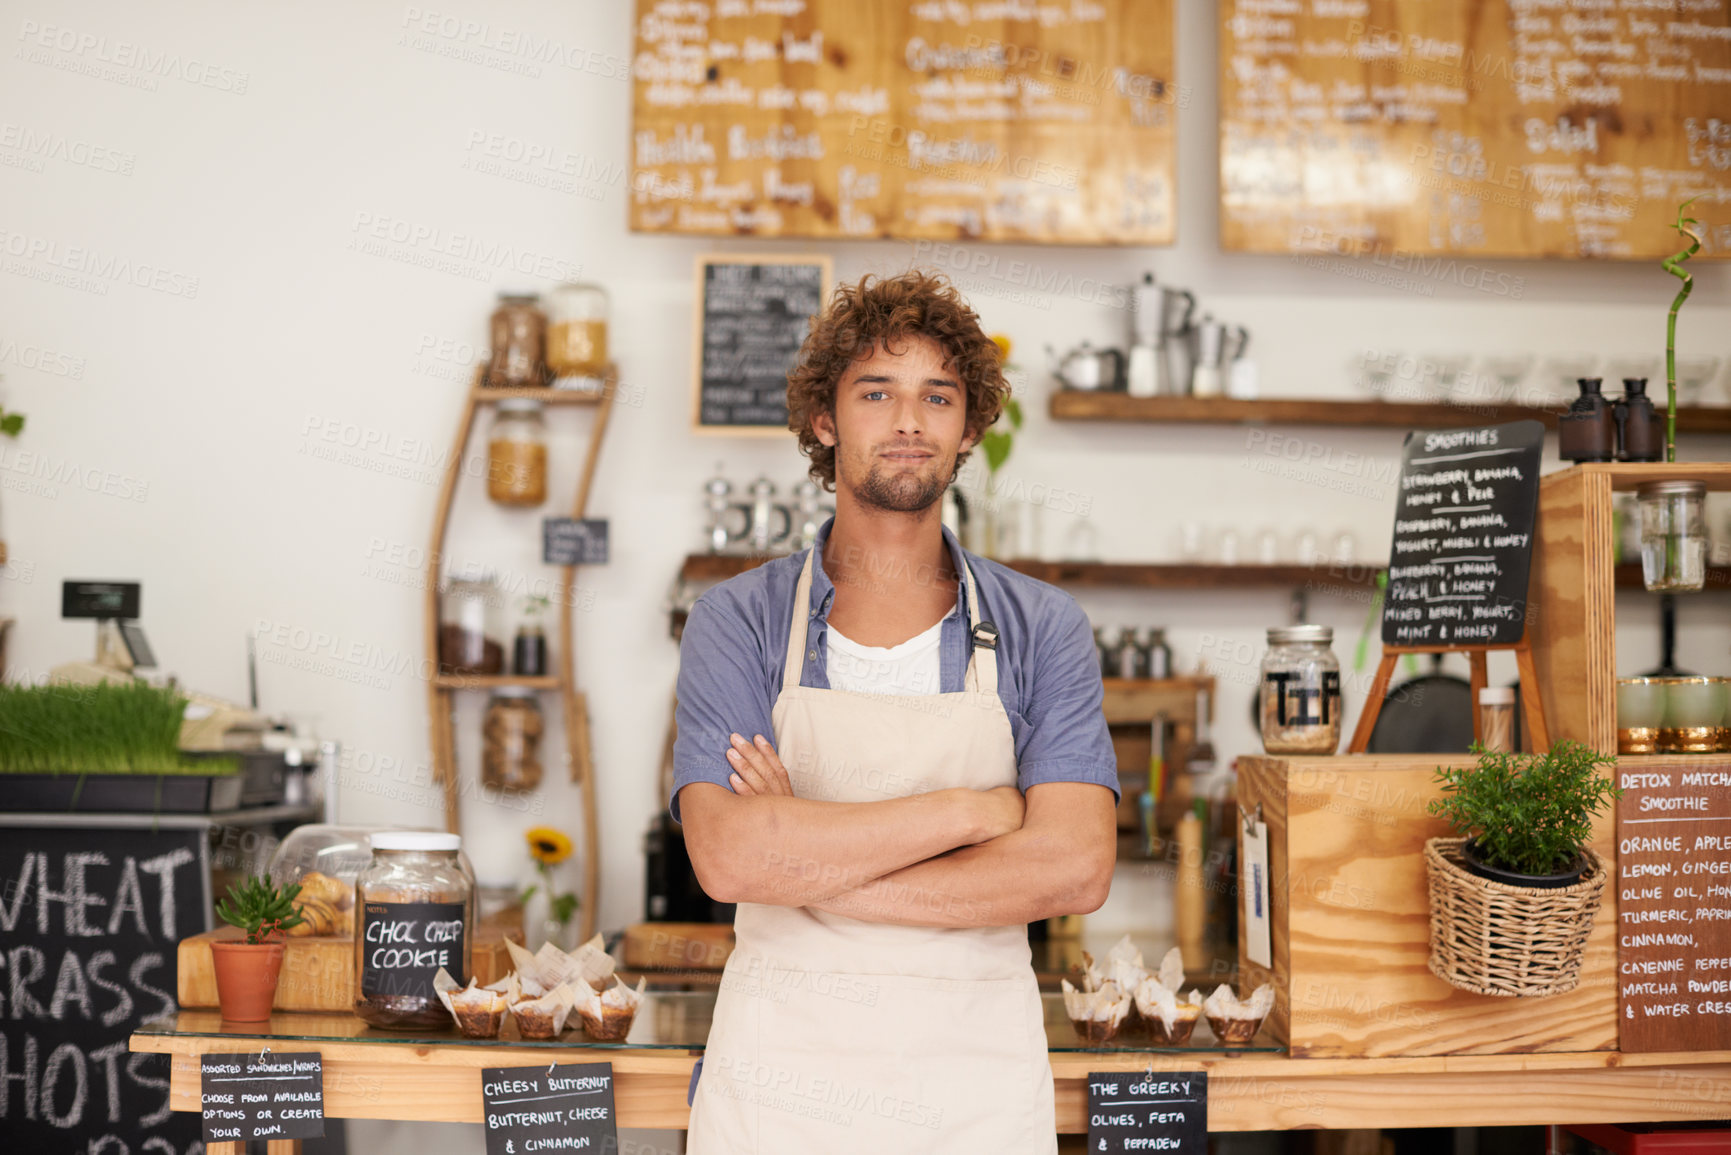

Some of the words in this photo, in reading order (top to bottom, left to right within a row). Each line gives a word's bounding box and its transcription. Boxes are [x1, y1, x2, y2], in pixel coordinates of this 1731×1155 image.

[1424, 429, 1498, 452] SMOOTHIES
[1494, 533, 1528, 548] HONEY
[1453, 580, 1496, 593] HONEY
[1384, 607, 1422, 621] MIXED
[1396, 624, 1432, 638] MINT
[1454, 624, 1497, 638] HONEY
[1620, 773, 1671, 789] DETOX
[1639, 796, 1709, 812] SMOOTHIE
[1620, 836, 1690, 854] ORANGE,
[1622, 862, 1678, 878] LEMON,
[1682, 860, 1731, 875] GINGE
[1622, 886, 1662, 900] OLIVE
[1673, 887, 1703, 901] OIL,
[1621, 908, 1694, 924] TURMERIC,
[1621, 934, 1698, 948] CINNAMON,
[372, 948, 449, 968] COOKIE
[1622, 959, 1684, 975] CAYENNE
[1695, 957, 1731, 971] PEPPE
[0, 944, 177, 1027] RASS
[1622, 982, 1678, 998] MATCHA
[1688, 979, 1731, 994] POWDE
[1625, 1003, 1634, 1019] &
[1644, 1002, 1690, 1017] WATER
[201, 1064, 242, 1074] ASSORTED
[484, 1080, 538, 1096] CHEESY
[547, 1076, 610, 1091] BUTTERNUT
[1089, 1083, 1118, 1096] THE
[1128, 1081, 1190, 1096] GREEKY
[201, 1093, 235, 1104] CHOOSE
[241, 1093, 268, 1104] FROM
[273, 1092, 321, 1103] AVAILABLE
[203, 1109, 246, 1120] OPTIONS
[256, 1110, 273, 1119] OR
[280, 1109, 323, 1119] CREATE
[488, 1111, 567, 1129] BUTTERNUT,
[568, 1107, 608, 1120] CHEESE
[1091, 1113, 1143, 1128] OLIVES,
[1149, 1112, 1185, 1124] FETA
[209, 1127, 241, 1138] YOUR
[505, 1139, 515, 1154] &
[525, 1136, 590, 1151] CINNAMON
[1098, 1137, 1107, 1151] &
[1123, 1137, 1181, 1150] PEPPADEW
